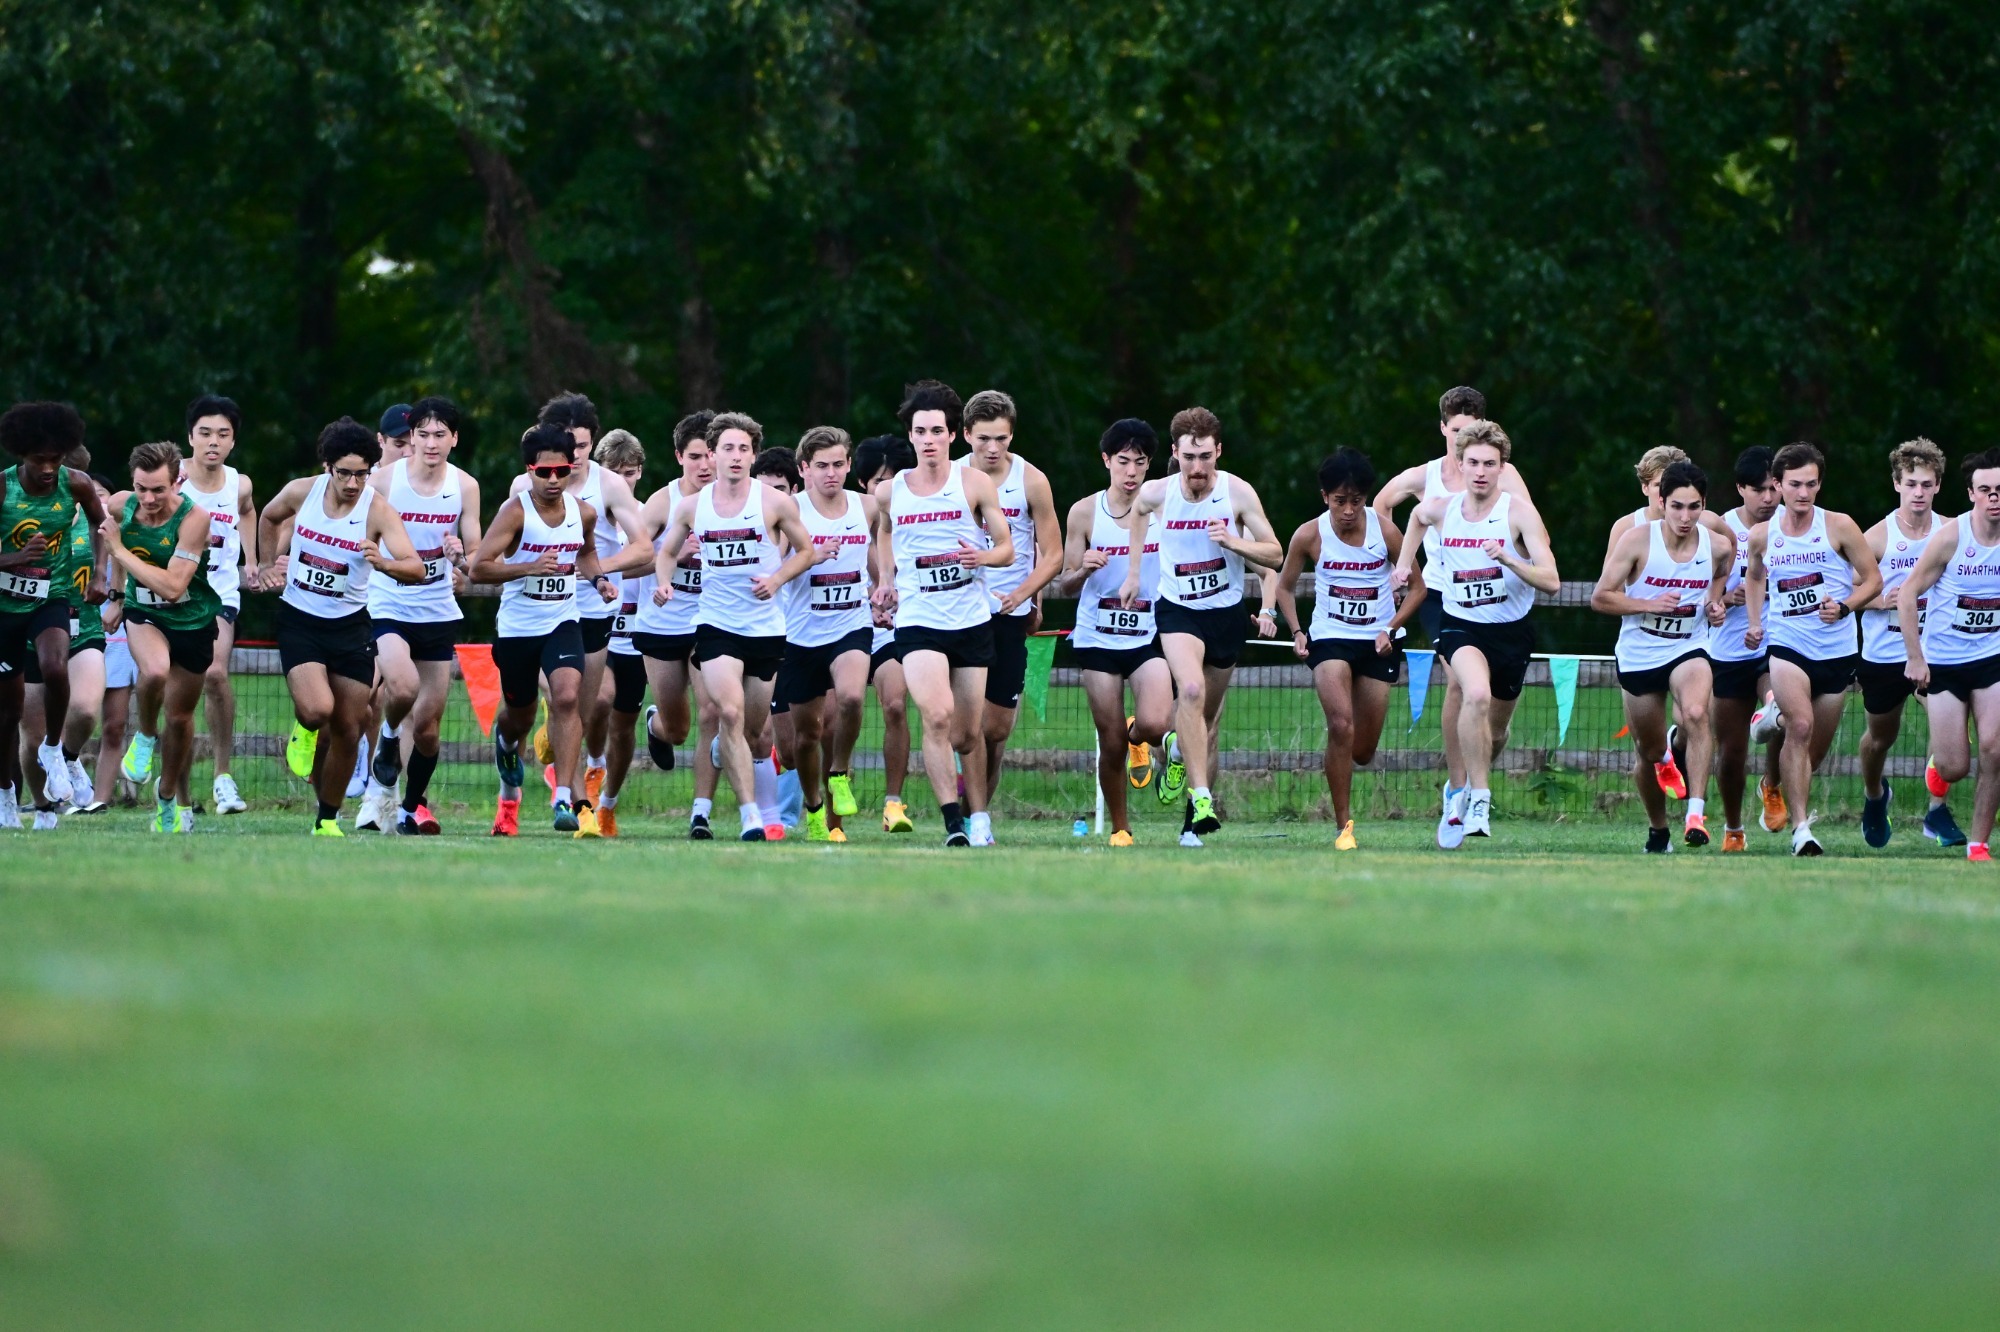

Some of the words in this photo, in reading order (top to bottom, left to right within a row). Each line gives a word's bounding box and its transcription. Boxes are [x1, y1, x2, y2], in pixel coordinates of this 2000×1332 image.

[398, 512, 457, 523] AVERFORD
[897, 510, 962, 525] HAVERFORD
[716, 543, 746, 558] 174
[1323, 558, 1385, 570] HAVERFORD
[1770, 552, 1826, 566] SWARTHMORE
[1890, 558, 1919, 570] SWART
[929, 567, 961, 584] 182
[1957, 564, 2000, 576] SWARTHM
[9, 577, 39, 594] 113
[306, 569, 336, 588] 192
[537, 578, 565, 593] 190
[684, 571, 701, 585] 18
[1188, 574, 1218, 591] 178
[1645, 576, 1709, 589] HAVERFORD
[823, 586, 851, 602] 177
[1463, 583, 1493, 599] 175
[1788, 589, 1817, 608] 306
[1339, 601, 1367, 616] 170
[1109, 612, 1139, 627] 169
[1654, 617, 1682, 632] 171
[1965, 612, 1994, 625] 304
